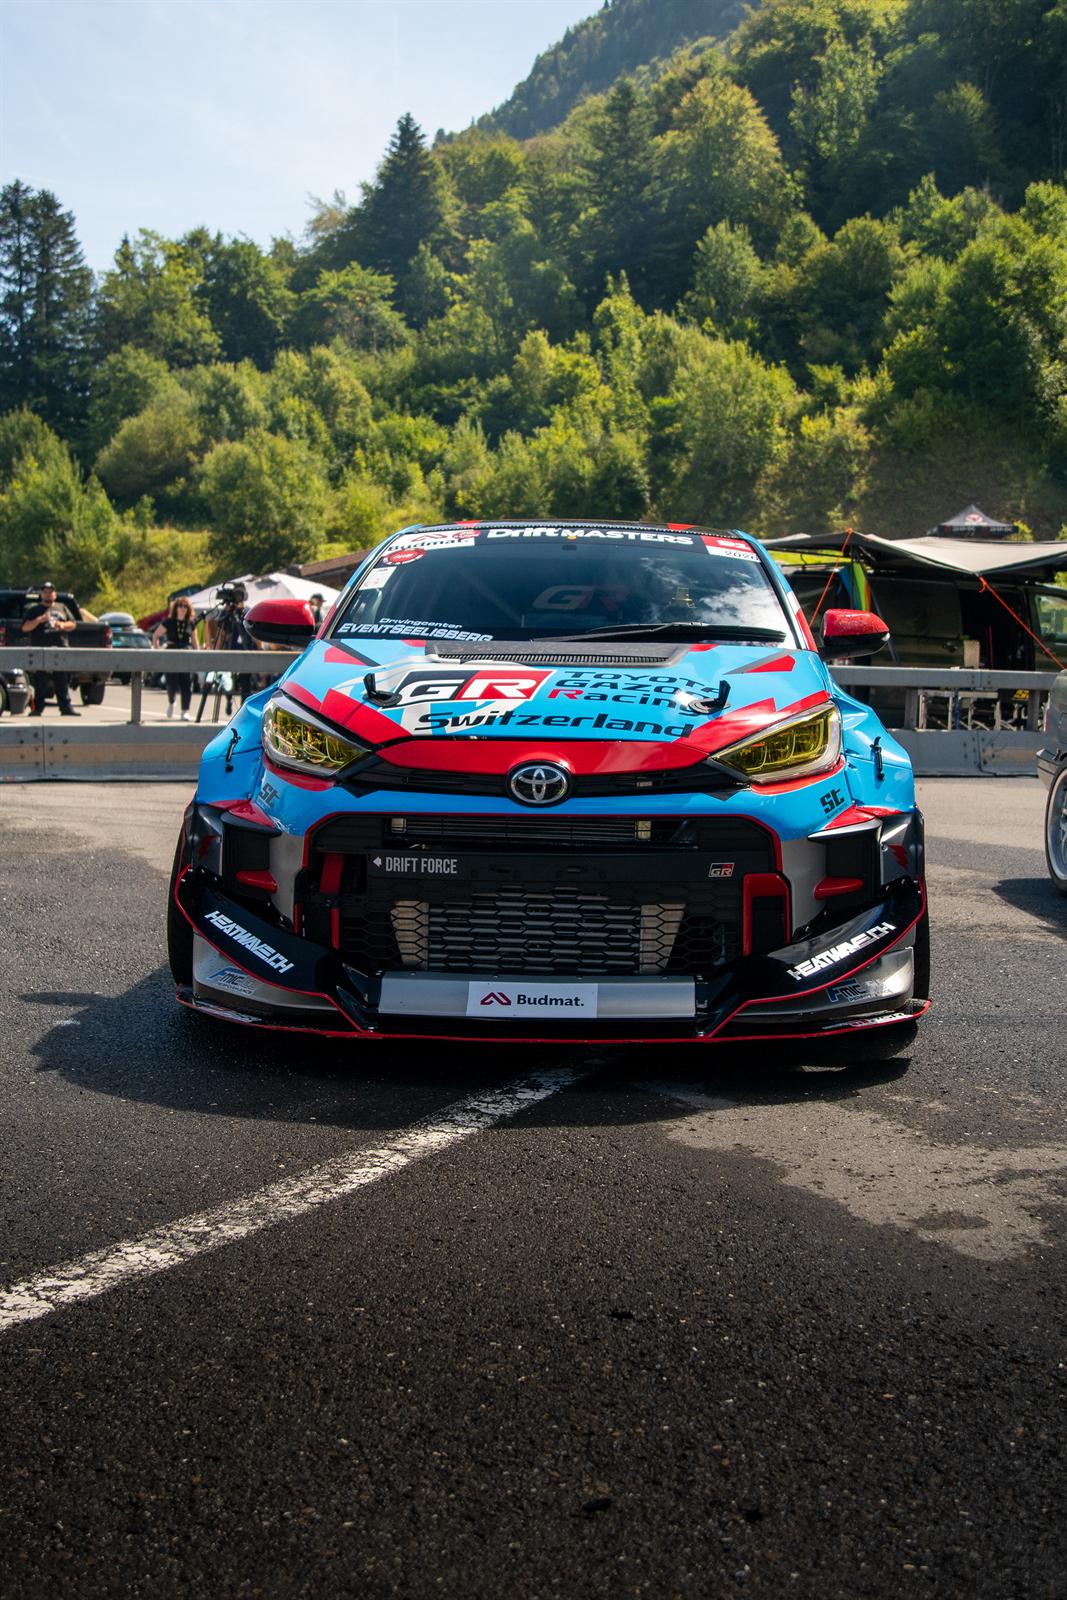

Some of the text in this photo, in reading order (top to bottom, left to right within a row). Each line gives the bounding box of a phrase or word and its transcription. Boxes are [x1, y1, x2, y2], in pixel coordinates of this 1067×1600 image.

[337, 622, 494, 642] EVENTSEELISBERG
[396, 679, 537, 706] GR
[414, 709, 694, 739] Switzerland
[385, 856, 457, 874] DRIFT FORCE
[517, 994, 584, 1007] Budmat.
